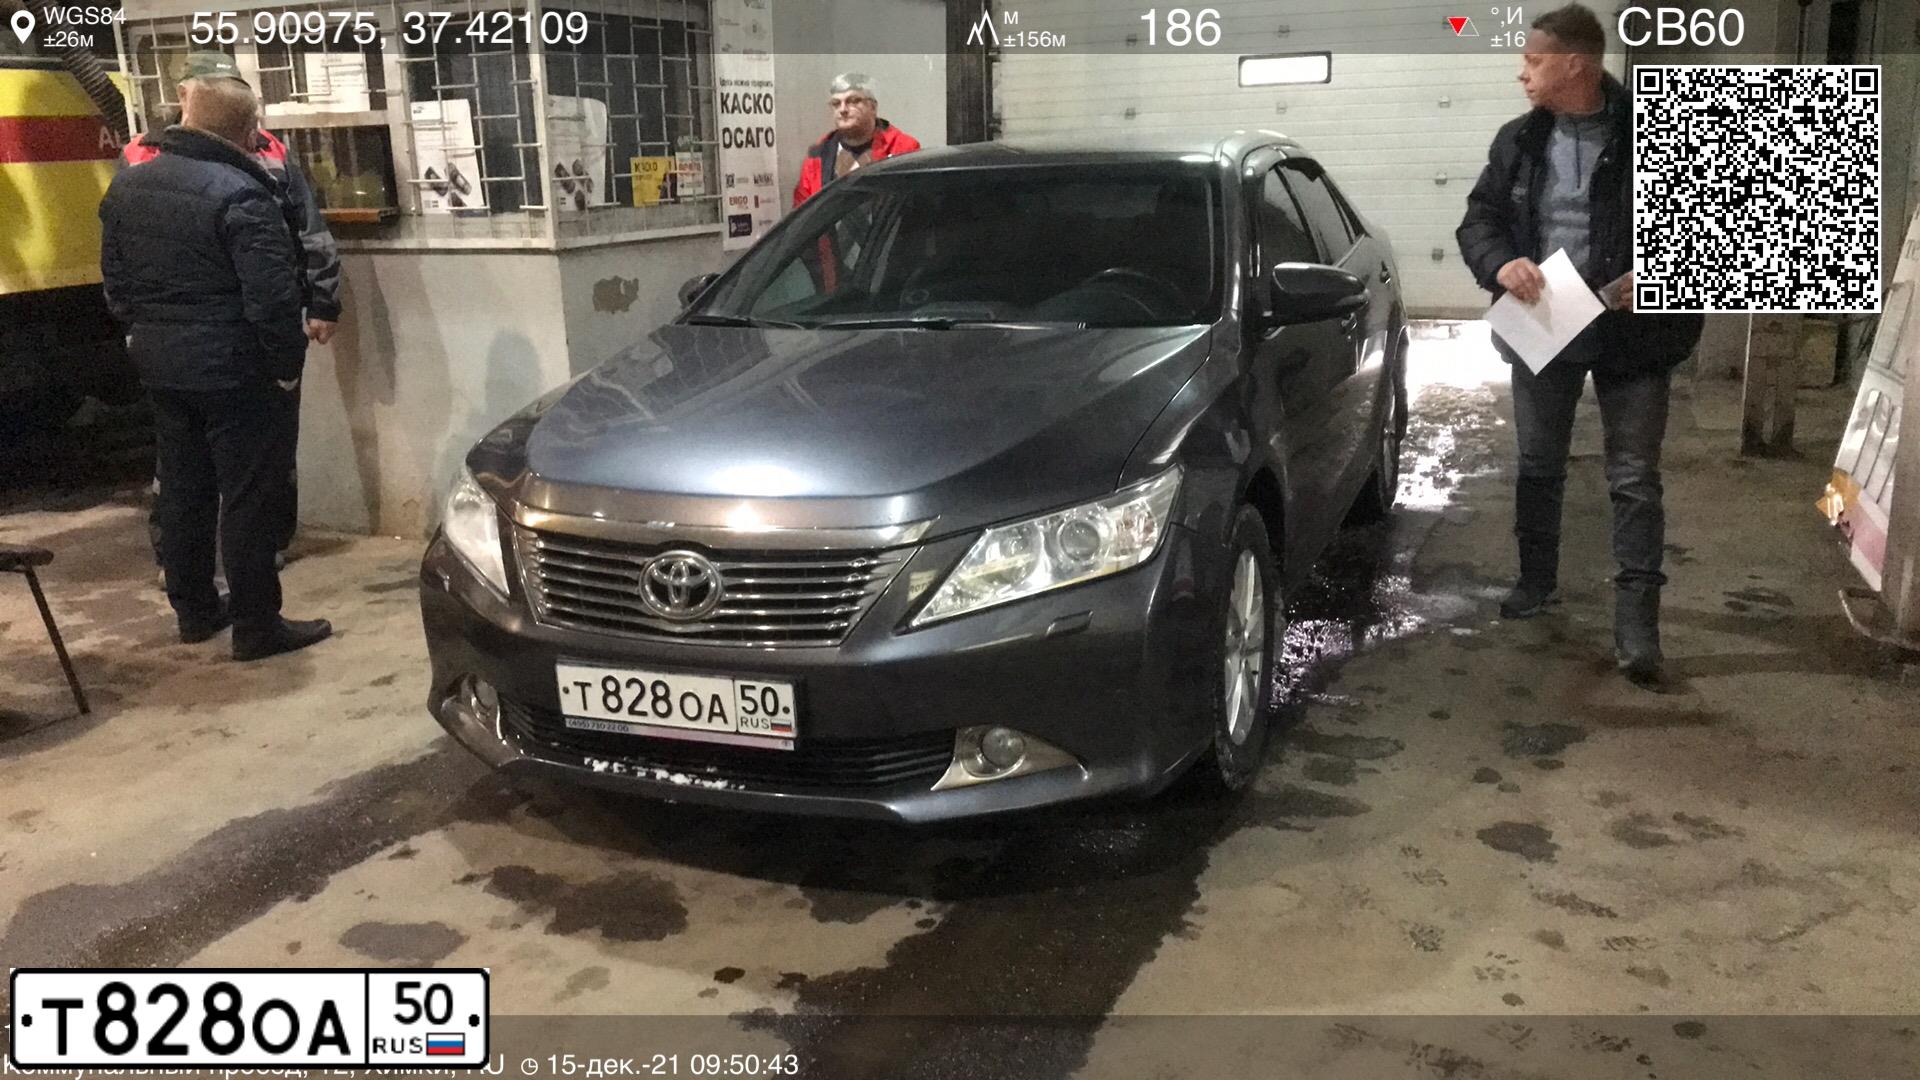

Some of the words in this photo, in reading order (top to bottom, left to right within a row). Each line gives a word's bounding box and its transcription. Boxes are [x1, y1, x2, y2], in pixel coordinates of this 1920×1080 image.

[720, 92, 773, 115] КАСКО
[721, 126, 775, 149] ОСАГО
[740, 684, 780, 717] 50
[740, 716, 770, 730] RUS
